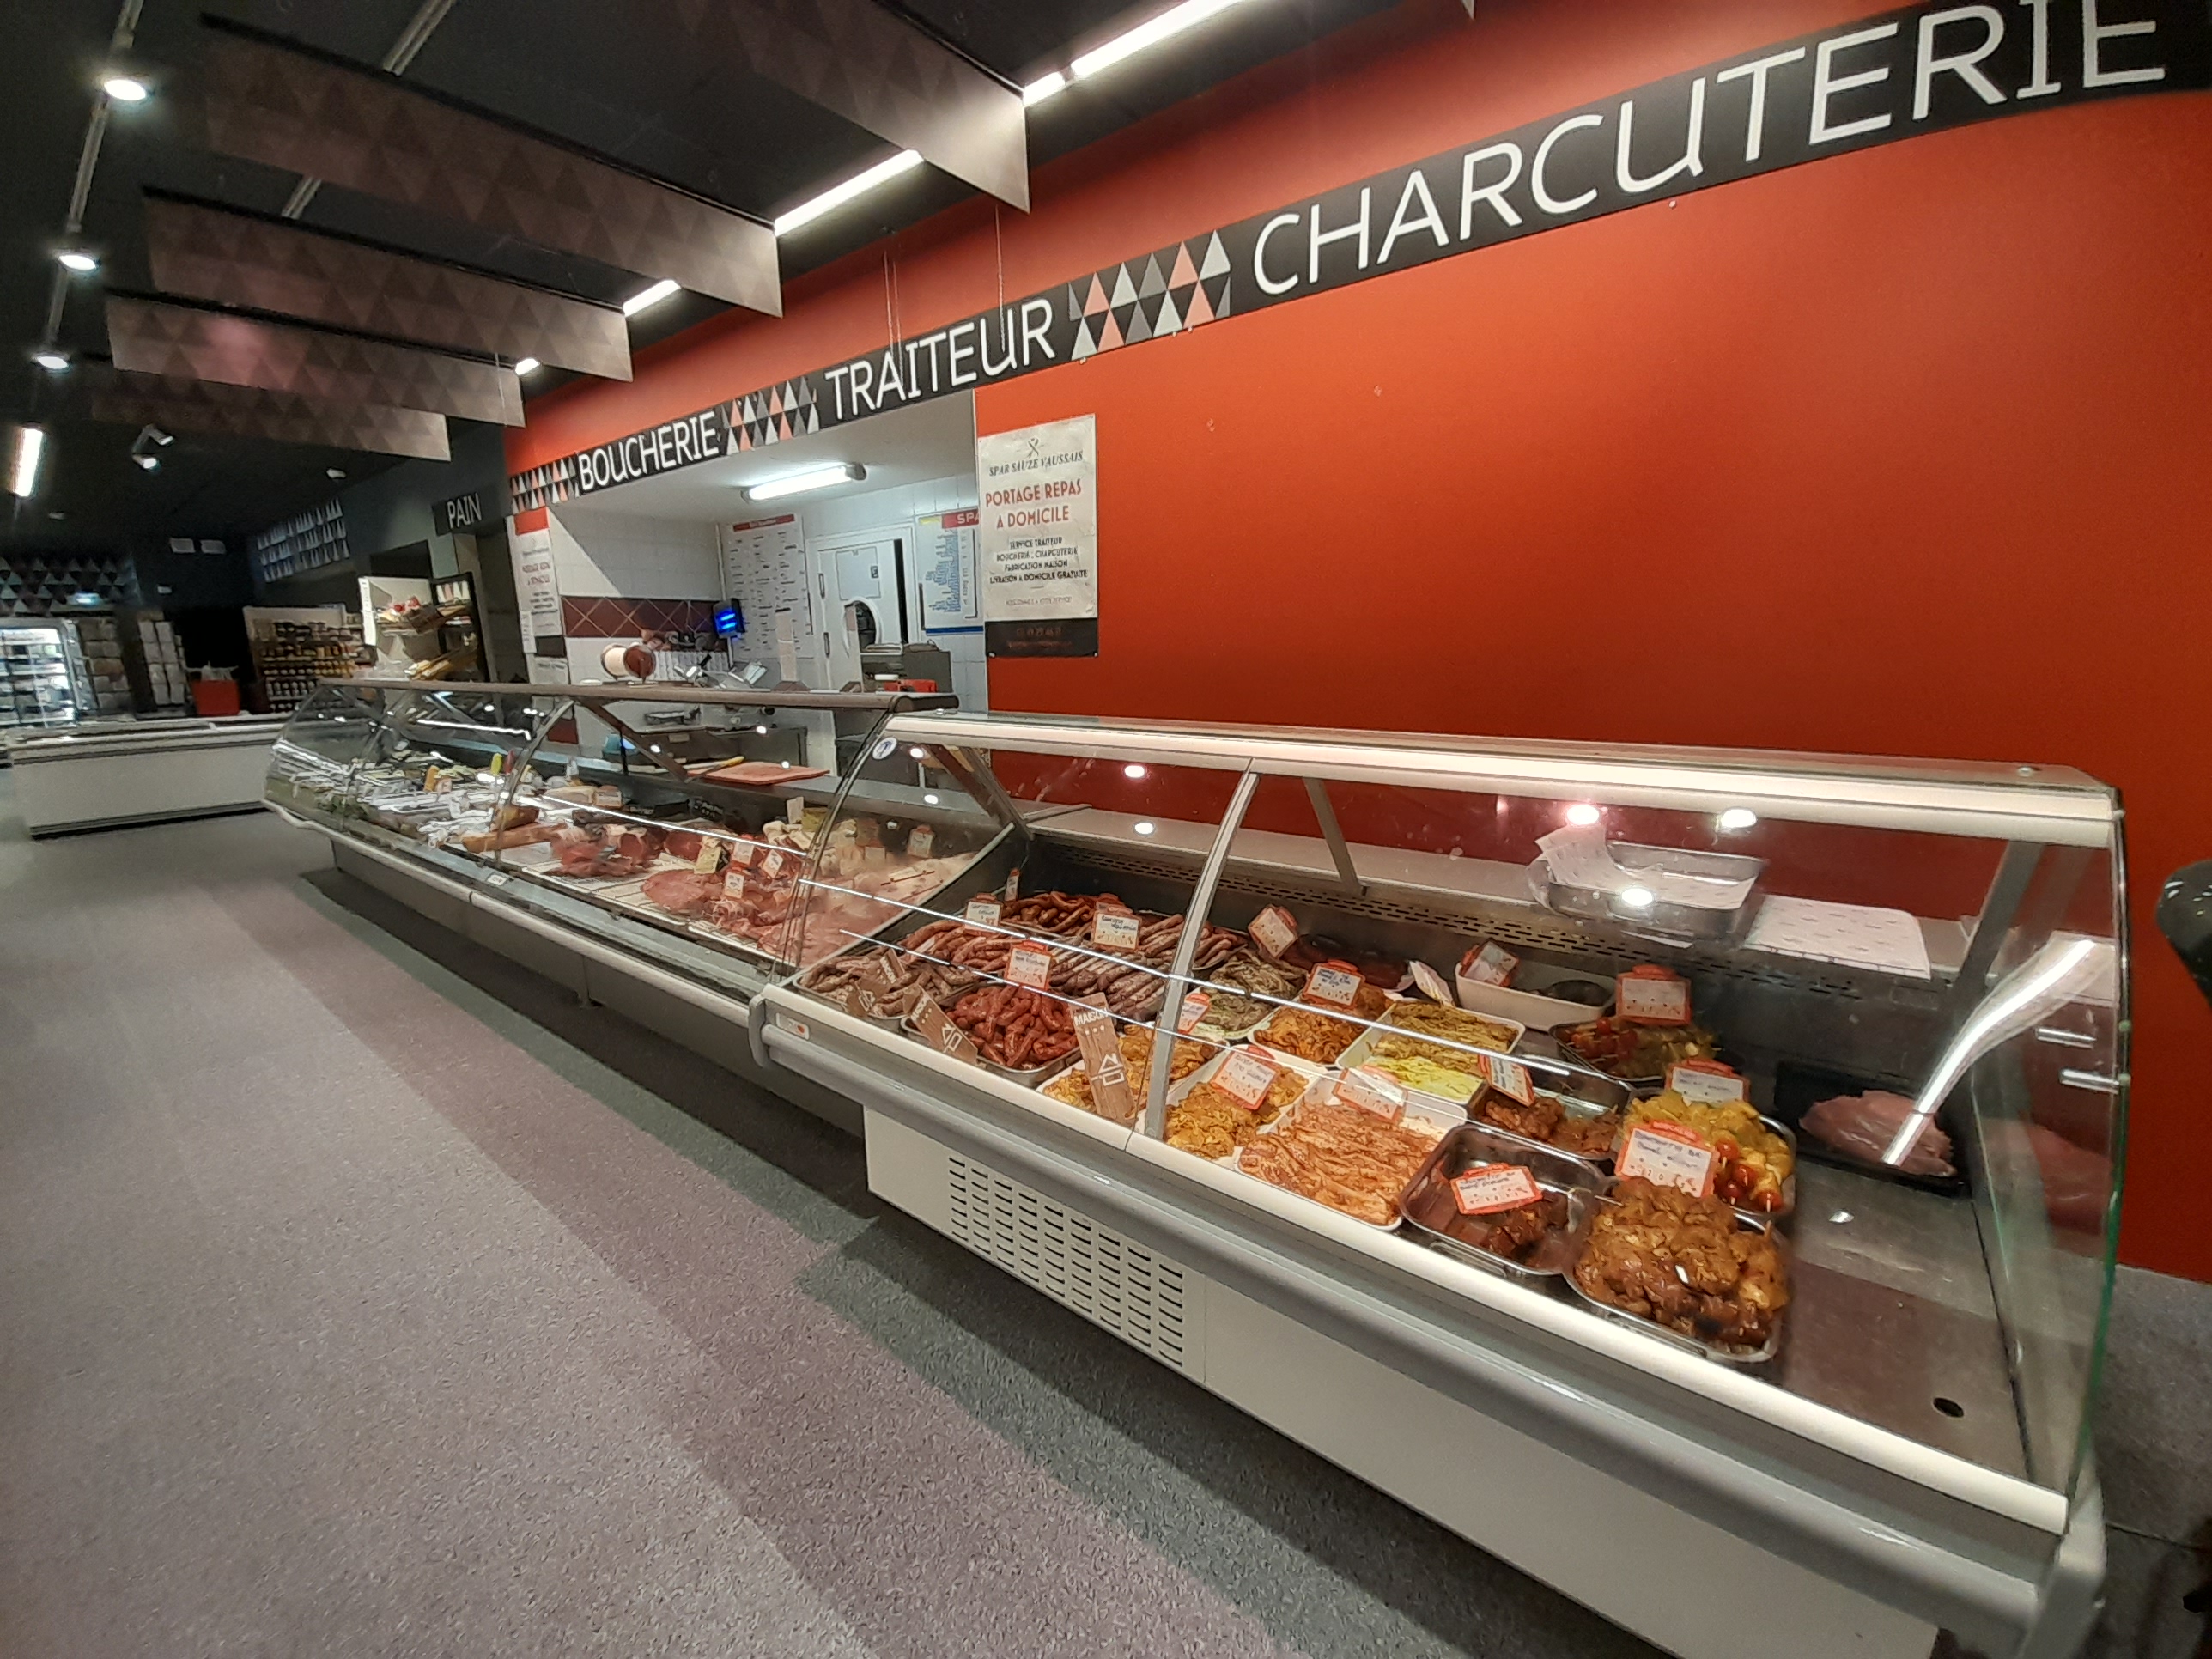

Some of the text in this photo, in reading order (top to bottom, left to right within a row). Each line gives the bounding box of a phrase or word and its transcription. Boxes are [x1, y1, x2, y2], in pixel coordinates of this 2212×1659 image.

[1254, 0, 2166, 295] CHARCUTERIE
[823, 297, 1056, 420] TRAITEUR
[578, 410, 720, 491] BOUCHERIE
[988, 450, 1084, 477] SPAR SAUZE VAUSSAIS
[447, 492, 482, 529] PAIN
[985, 477, 1082, 508] PORTAGE REPAS
[997, 505, 1070, 529] A DOMICILE
